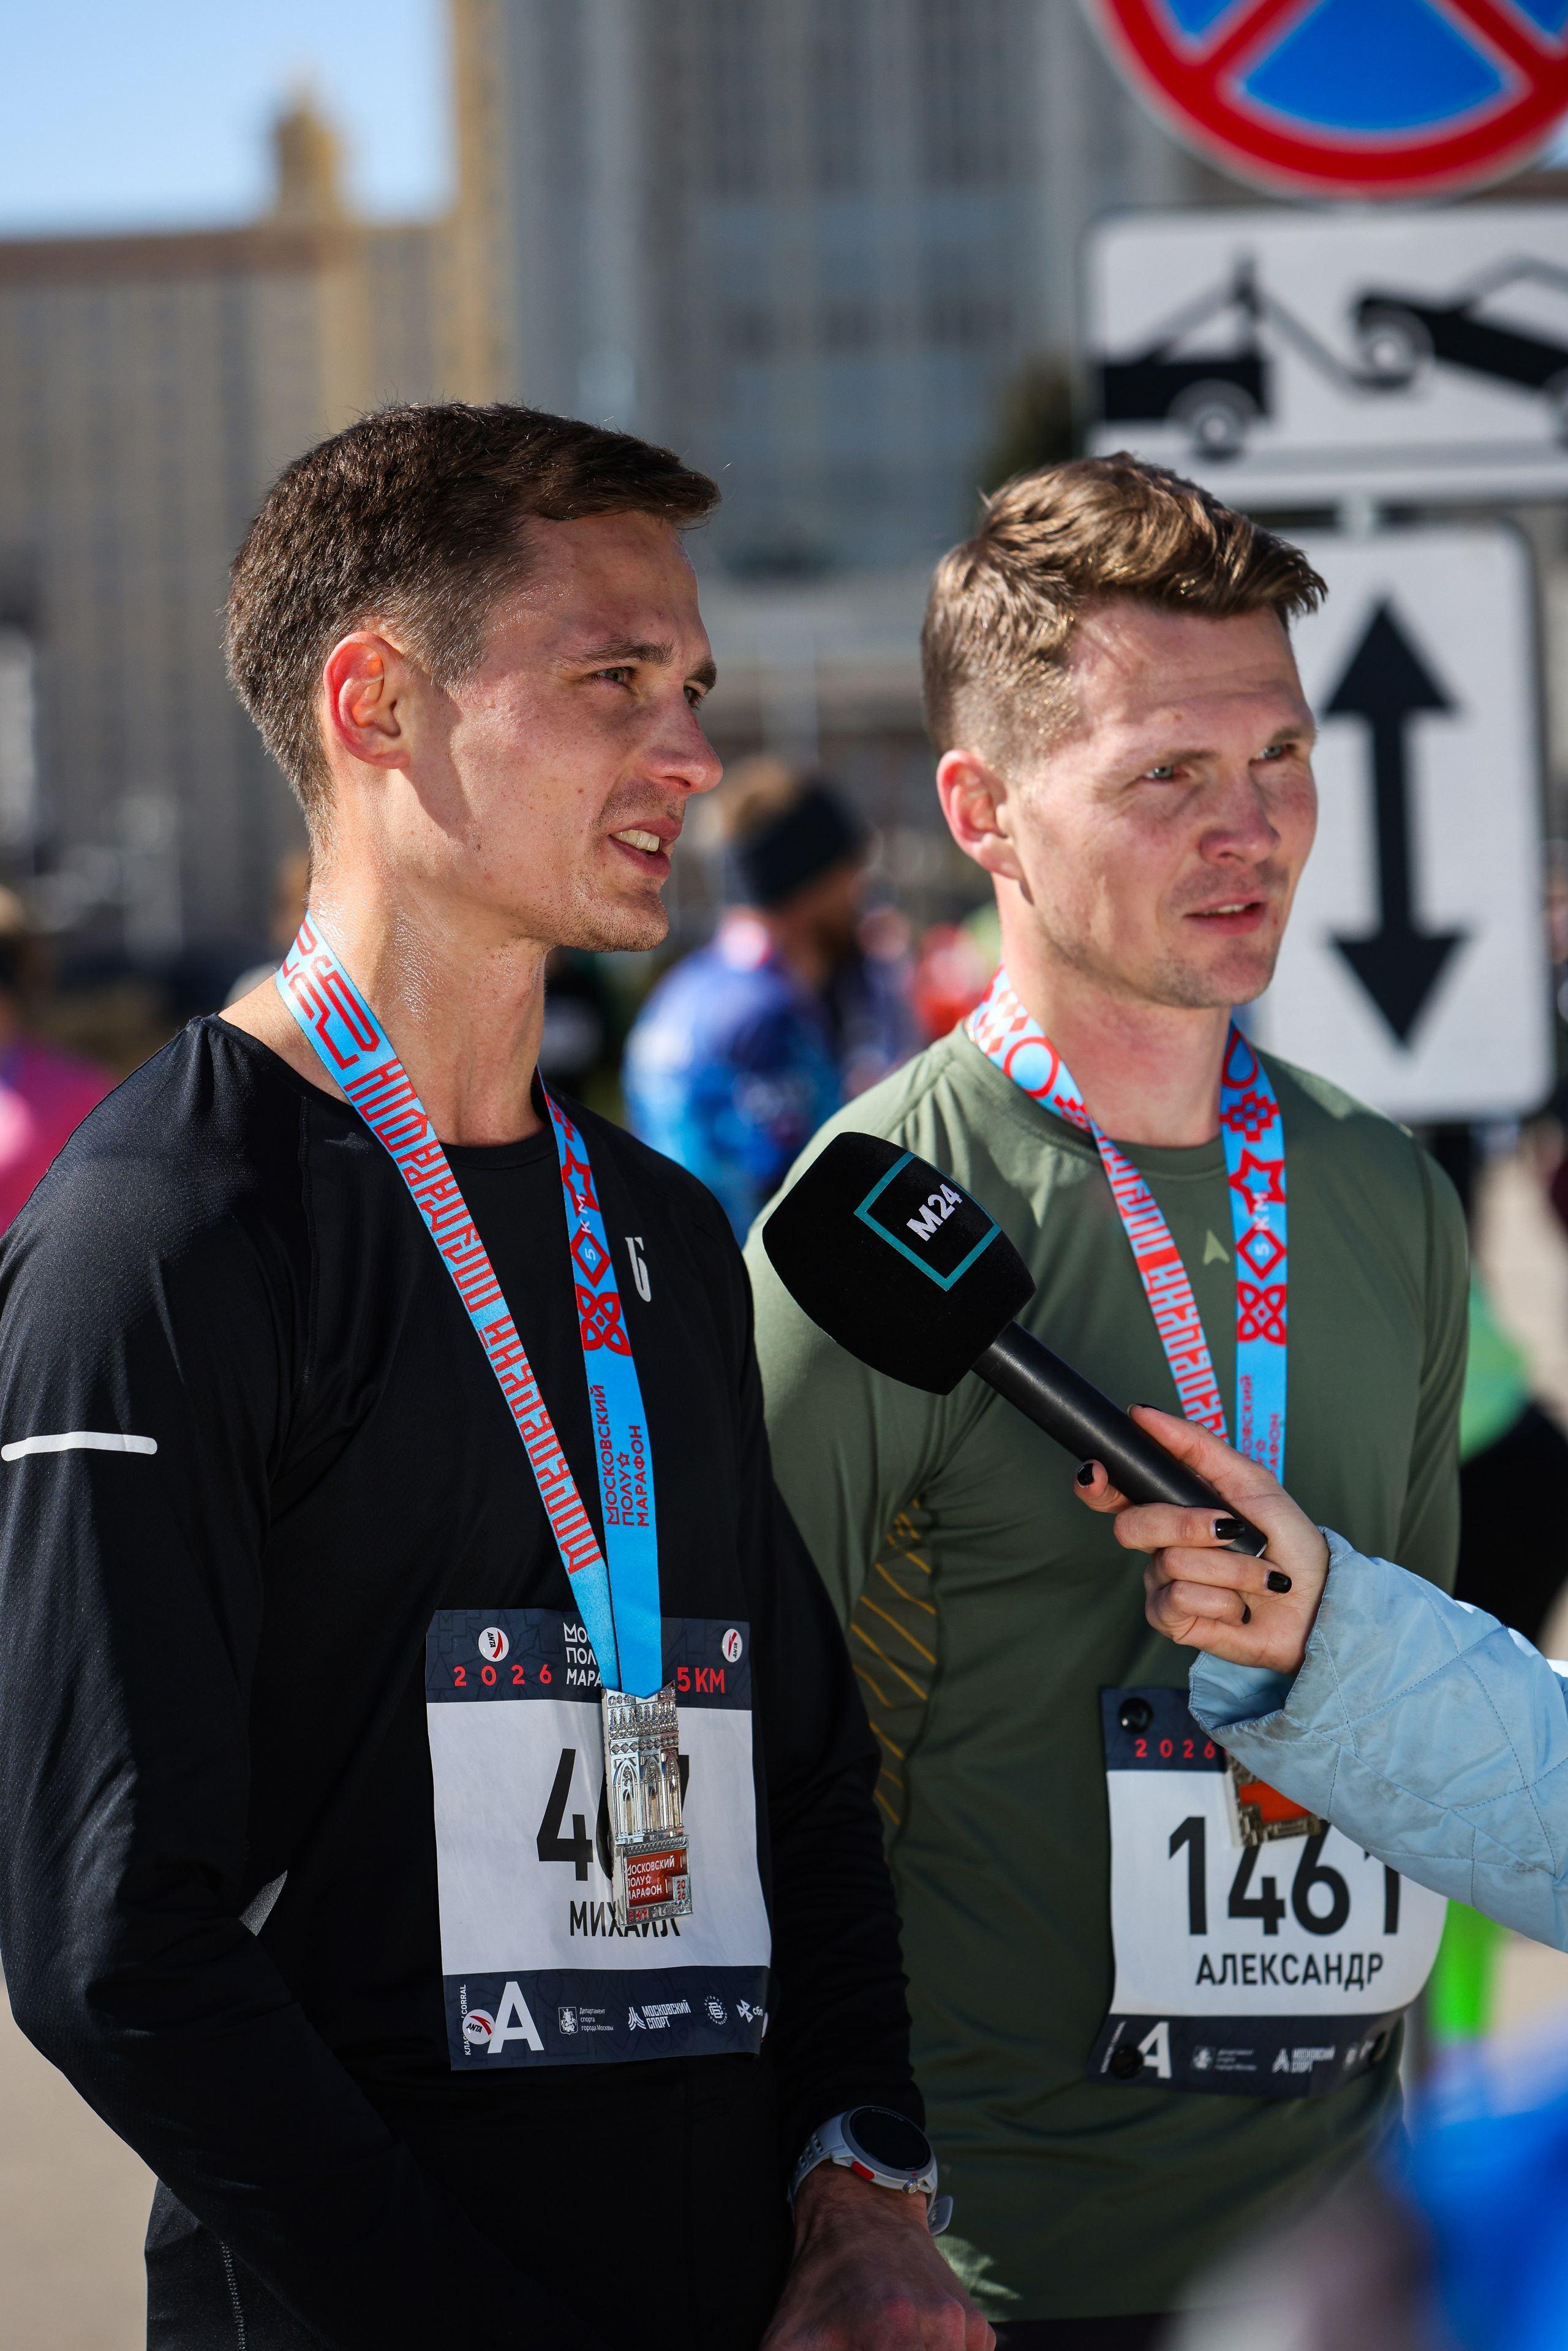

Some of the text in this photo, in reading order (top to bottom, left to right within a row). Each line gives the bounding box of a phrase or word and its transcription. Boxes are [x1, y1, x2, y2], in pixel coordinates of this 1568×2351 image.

[584, 1248, 596, 1261] 5
[1239, 1374, 1253, 1458] ОВСКИЙ
[590, 1384, 620, 1525] МОСКОВСКИЙ
[628, 1425, 649, 1526] МАРАФОН
[618, 1468, 635, 1526] ПОЛУ
[487, 1631, 496, 1648] ANTA
[565, 1647, 597, 1665] ПОЛ
[453, 1664, 552, 1686] 2026
[566, 1668, 603, 1687] МАРА
[677, 1667, 691, 1692] 5
[1134, 1738, 1216, 1759] 2026
[1168, 1816, 1401, 1937] 1461
[1195, 1953, 1385, 1992] АЛЕКСАНДР
[641, 1999, 692, 2018] МОСКОВСКИЙ
[466, 2023, 483, 2033] ANTA
[646, 2016, 671, 2029] СПОРТ
